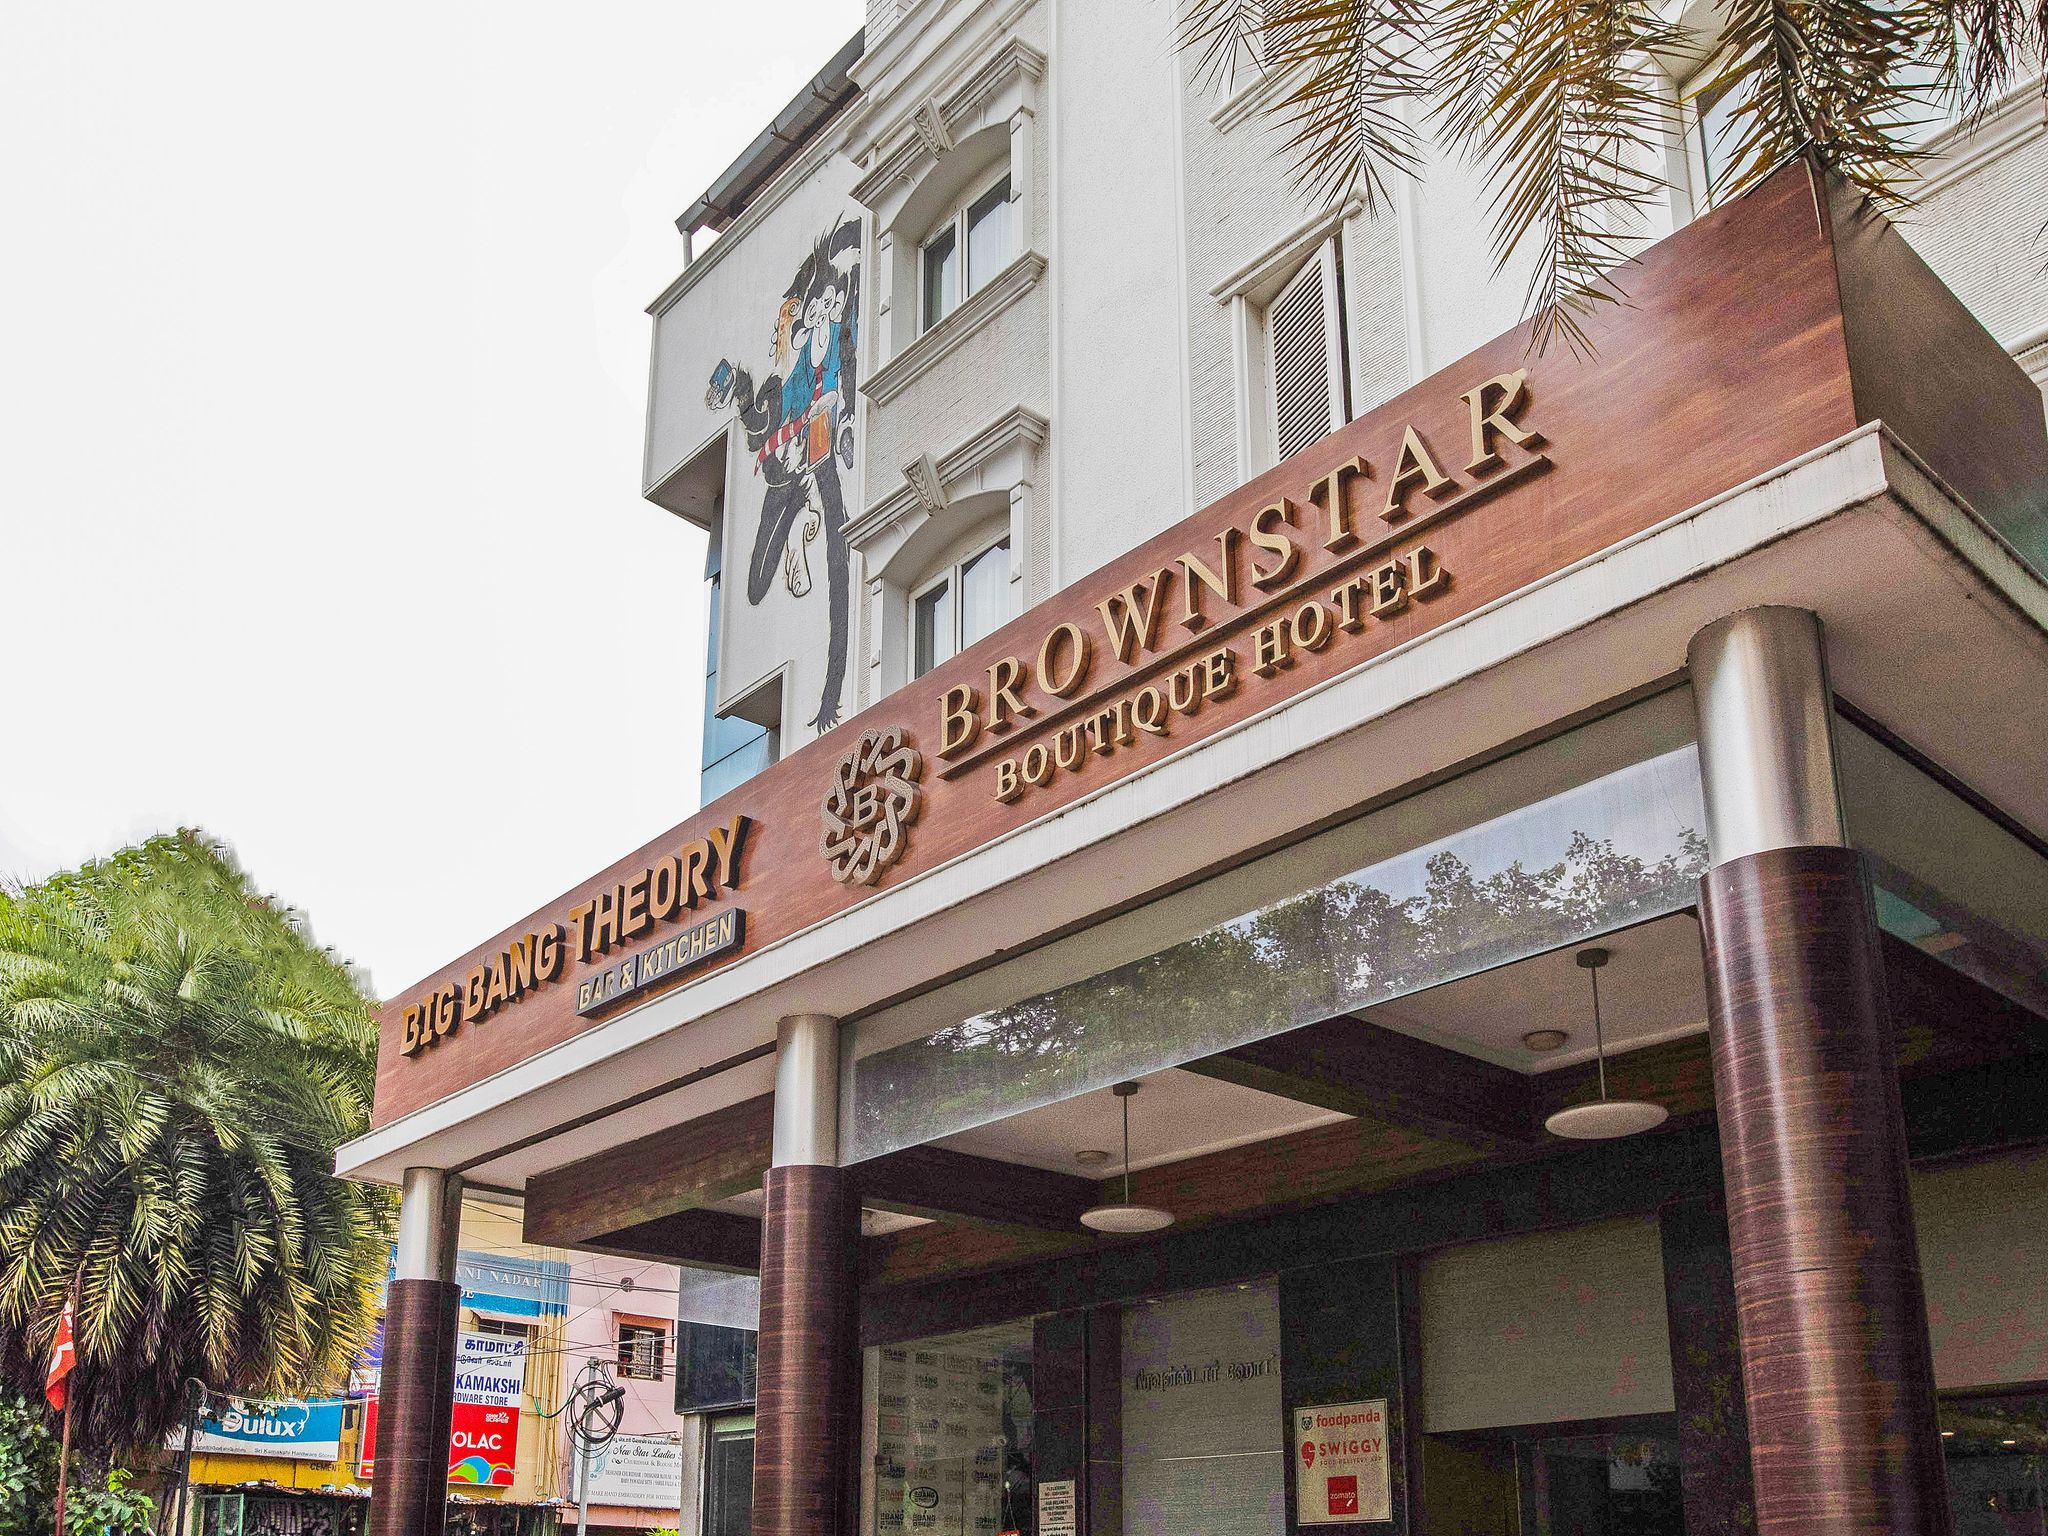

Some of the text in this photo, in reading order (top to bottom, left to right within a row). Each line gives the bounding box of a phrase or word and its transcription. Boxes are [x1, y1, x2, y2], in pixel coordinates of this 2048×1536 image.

[936, 368, 1550, 760] BROWNSTAR
[994, 545, 1450, 803] BOUTIQUE HOTEL
[400, 815, 752, 1058] BIG BANG THEORY
[578, 913, 732, 1010] BAR & KITCHEN
[490, 1271, 541, 1288] NADAR
[456, 1374, 520, 1395] KAMAKSHI
[485, 1395, 508, 1406] STORE
[222, 1411, 297, 1437] Dulux
[1316, 1409, 1381, 1428] foodpanda
[452, 1431, 502, 1450] OLAC
[1319, 1438, 1381, 1457] SWIGGY
[613, 1445, 631, 1455] New
[633, 1446, 649, 1457] Star
[651, 1448, 676, 1459] Ladies
[1329, 1491, 1356, 1500] zomato
